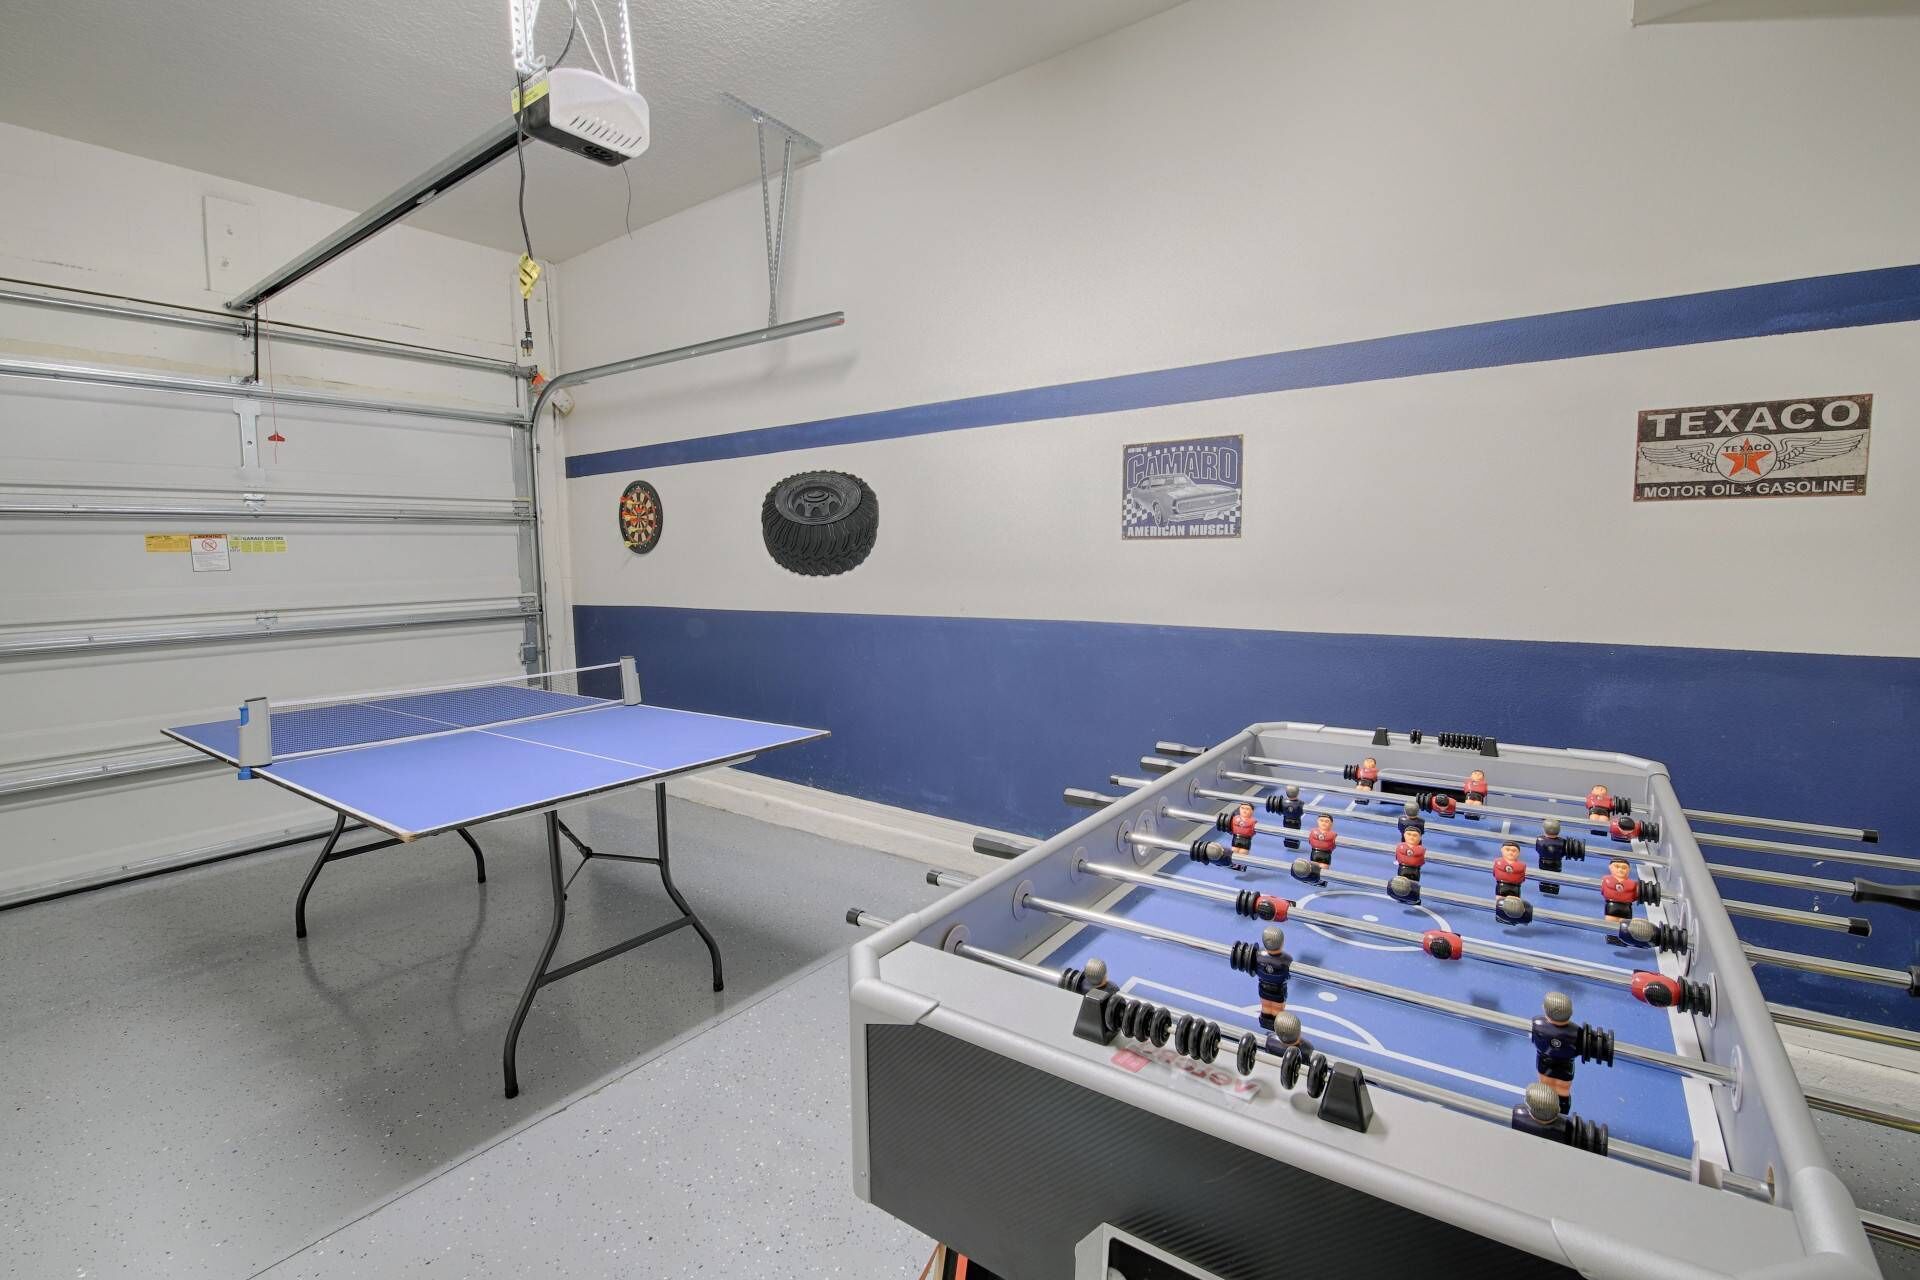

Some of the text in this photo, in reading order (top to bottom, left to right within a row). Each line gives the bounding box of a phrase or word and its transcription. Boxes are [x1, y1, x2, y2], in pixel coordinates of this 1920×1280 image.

[1647, 400, 1860, 438] TEXACO
[1724, 443, 1772, 453] TEXACO
[1127, 446, 1238, 490] CAMARO
[1643, 479, 1855, 498] MOTOR OIL GASOLINE
[1127, 523, 1236, 537] AMERICAN MUSCLE
